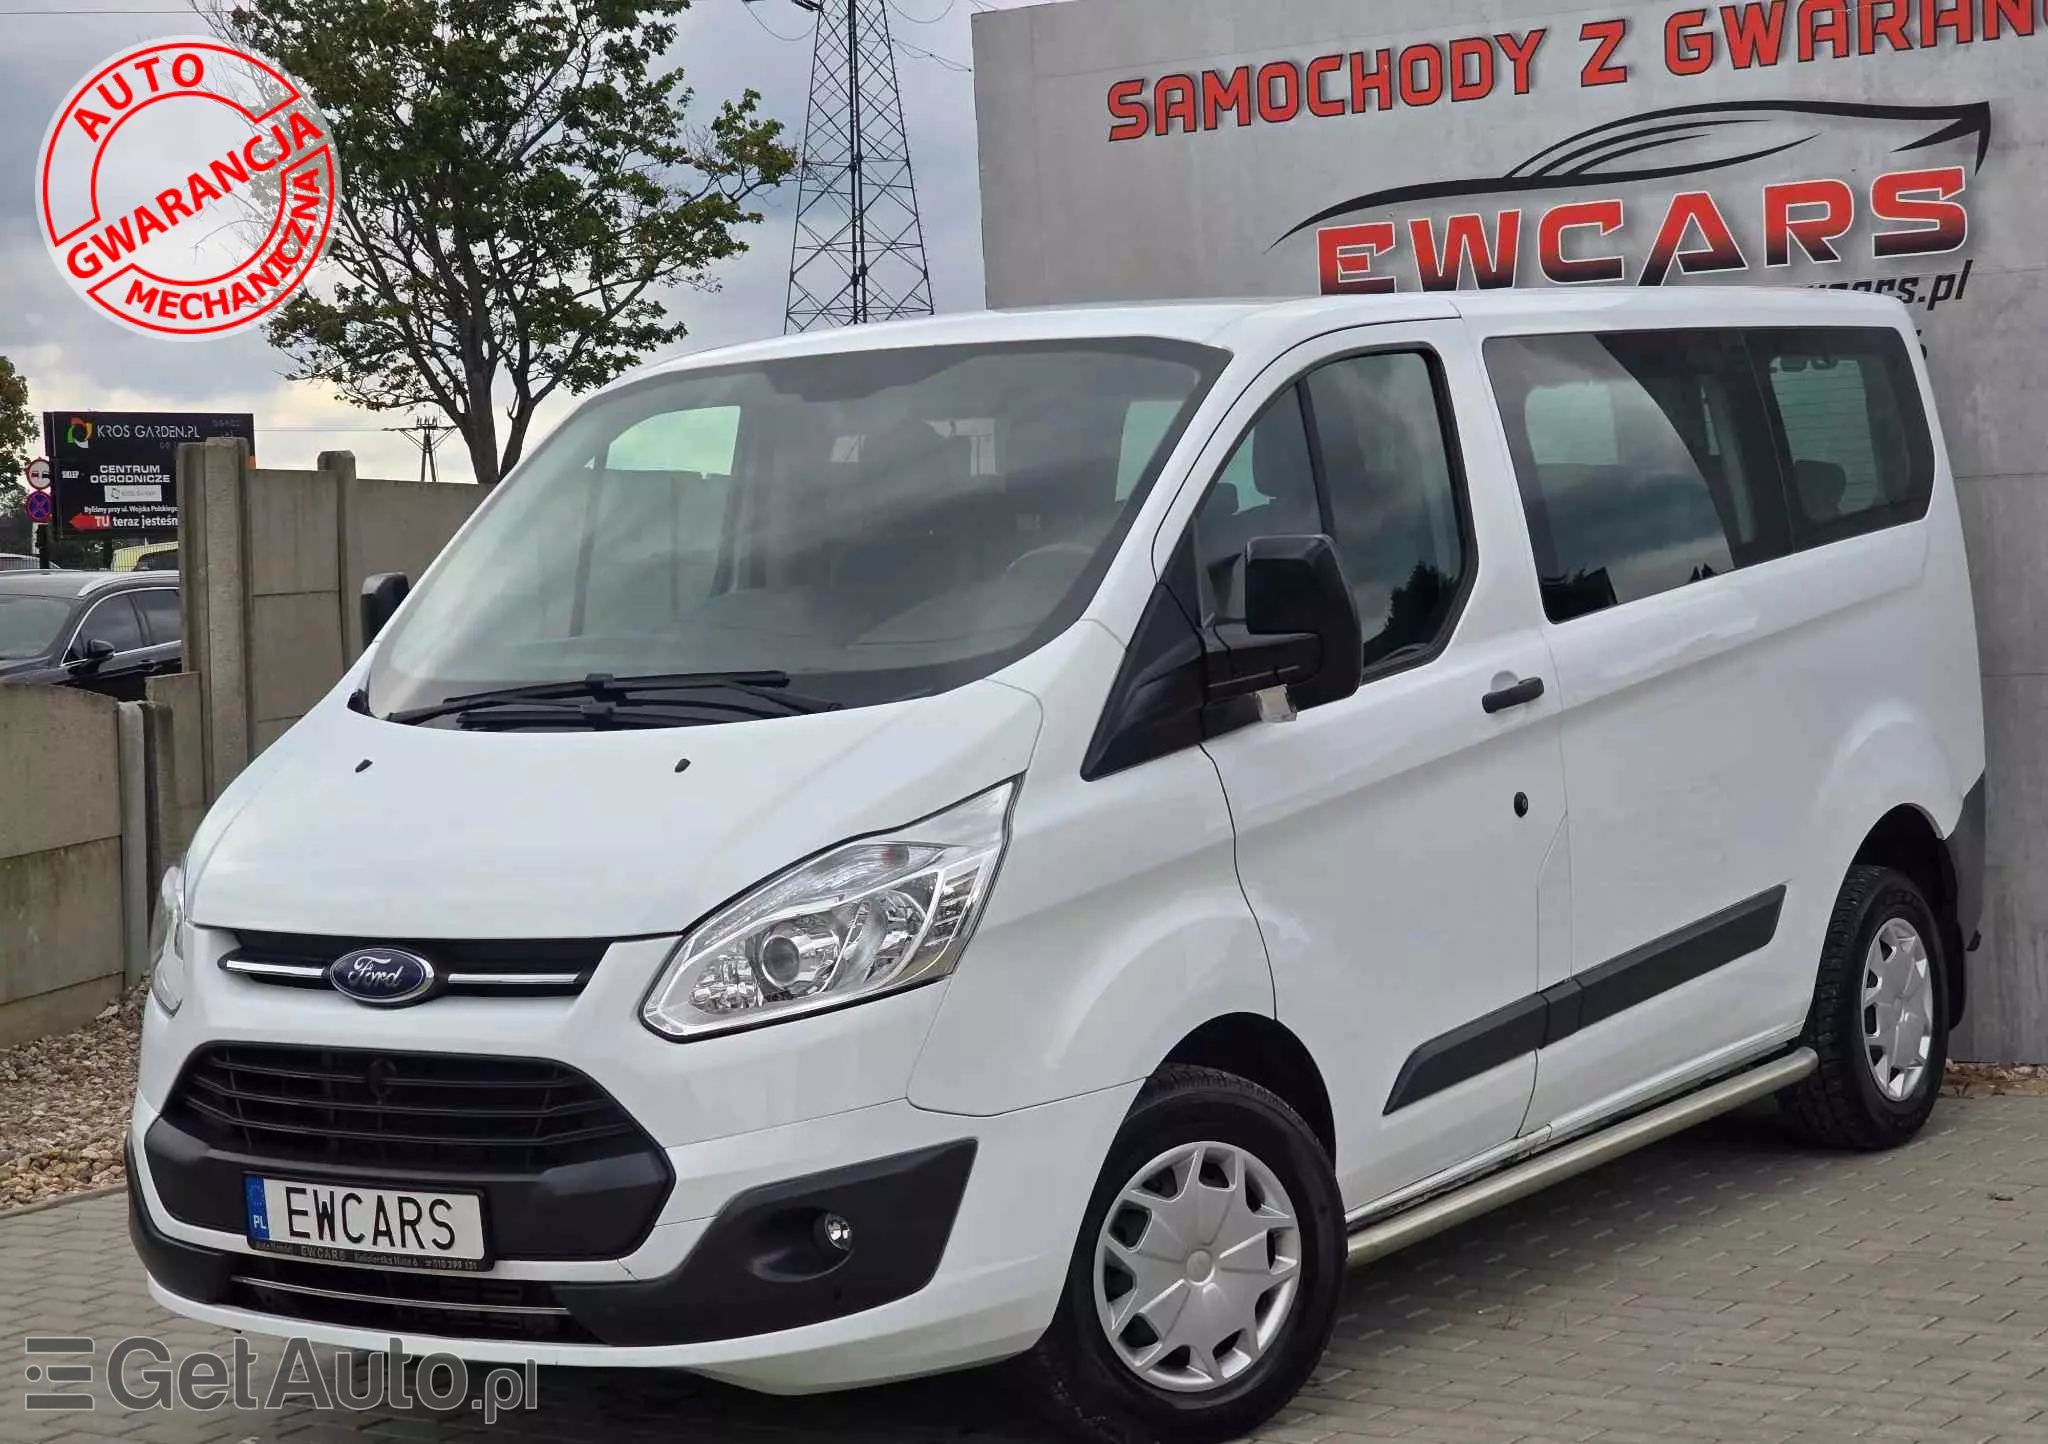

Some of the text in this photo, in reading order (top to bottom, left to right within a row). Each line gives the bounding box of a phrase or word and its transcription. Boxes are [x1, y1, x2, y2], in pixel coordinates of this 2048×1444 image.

[1107, 28, 1547, 142] SAMOCHODY
[1579, 17, 1629, 88] Z
[1315, 165, 1968, 296] EWCARS
[96, 424, 201, 439] KROS GARDEN.PL
[99, 464, 161, 475] CENTRUM
[89, 474, 171, 484] OGRODNICZE
[95, 514, 111, 528] TU
[112, 515, 140, 527] teraz
[347, 955, 405, 989] Ford
[252, 1214, 268, 1230] PL
[284, 1185, 456, 1251] EWCARS
